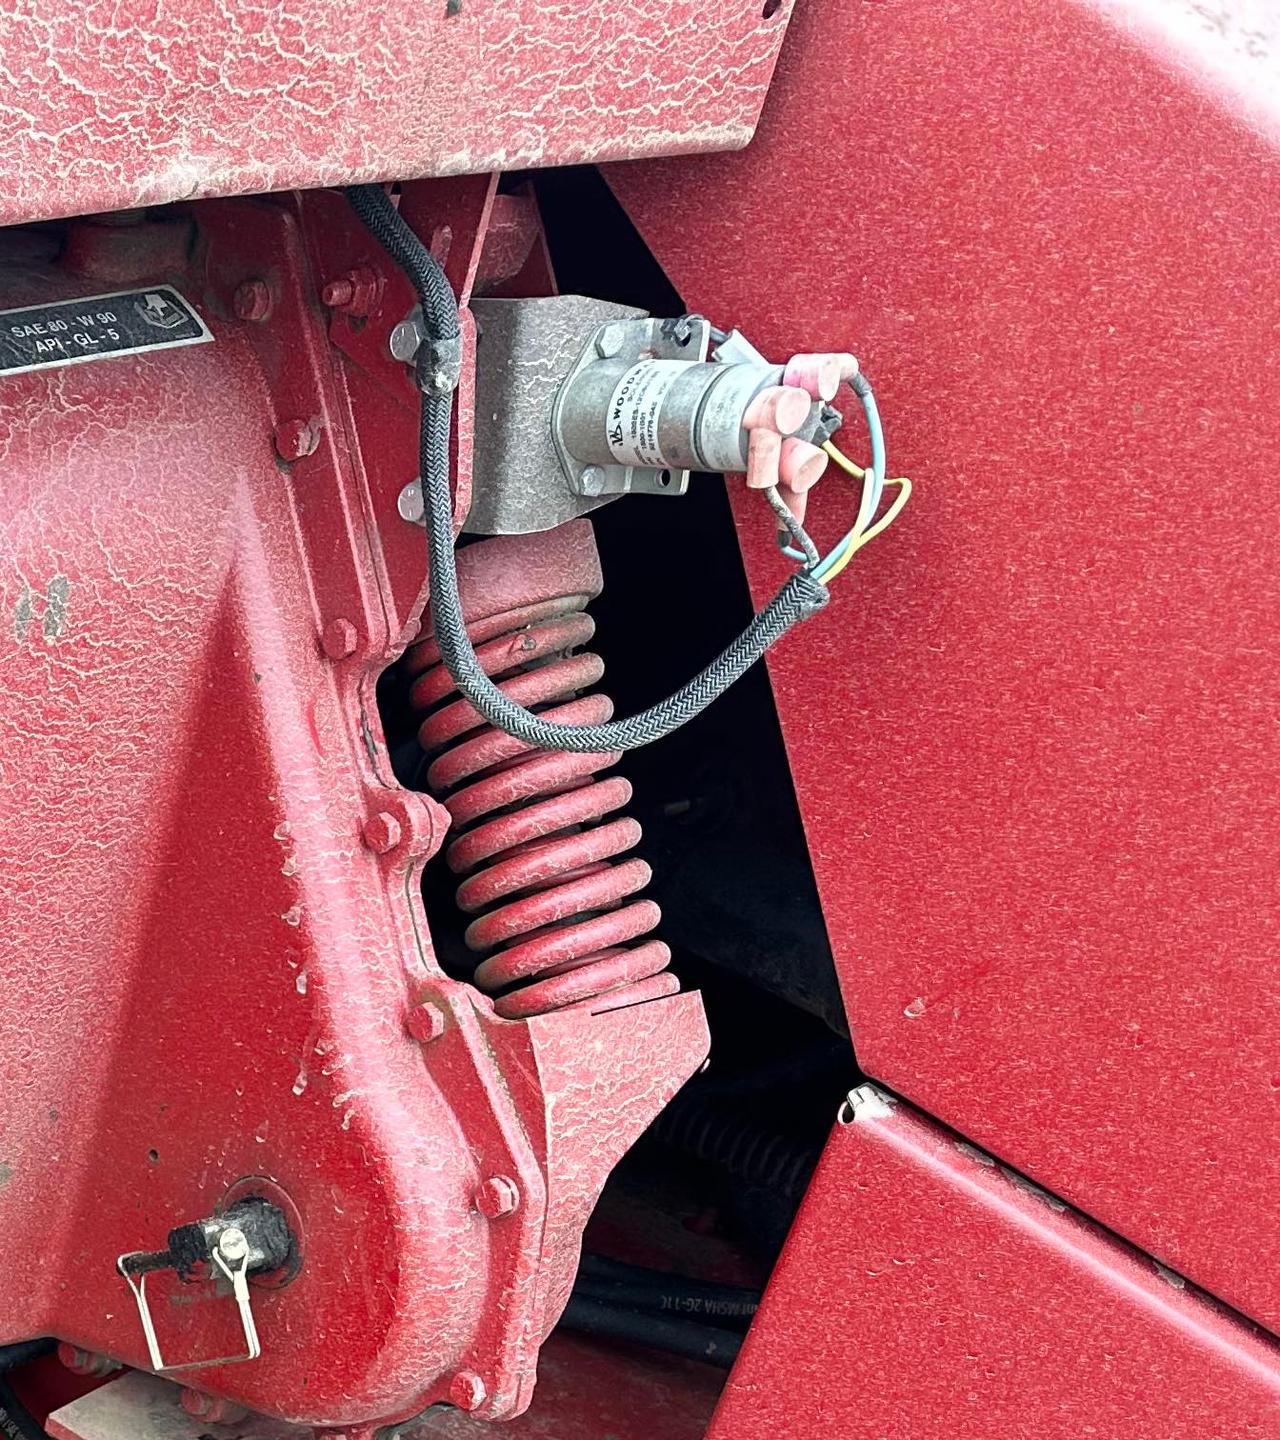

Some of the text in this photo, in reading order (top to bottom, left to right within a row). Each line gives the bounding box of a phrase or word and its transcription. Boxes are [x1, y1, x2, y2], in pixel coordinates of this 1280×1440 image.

[10, 323, 47, 338] SAE
[48, 319, 68, 333] 80
[76, 314, 96, 328] W
[96, 311, 118, 324] 90
[35, 337, 64, 353] API
[73, 332, 99, 346] GL
[108, 328, 120, 341] 5
